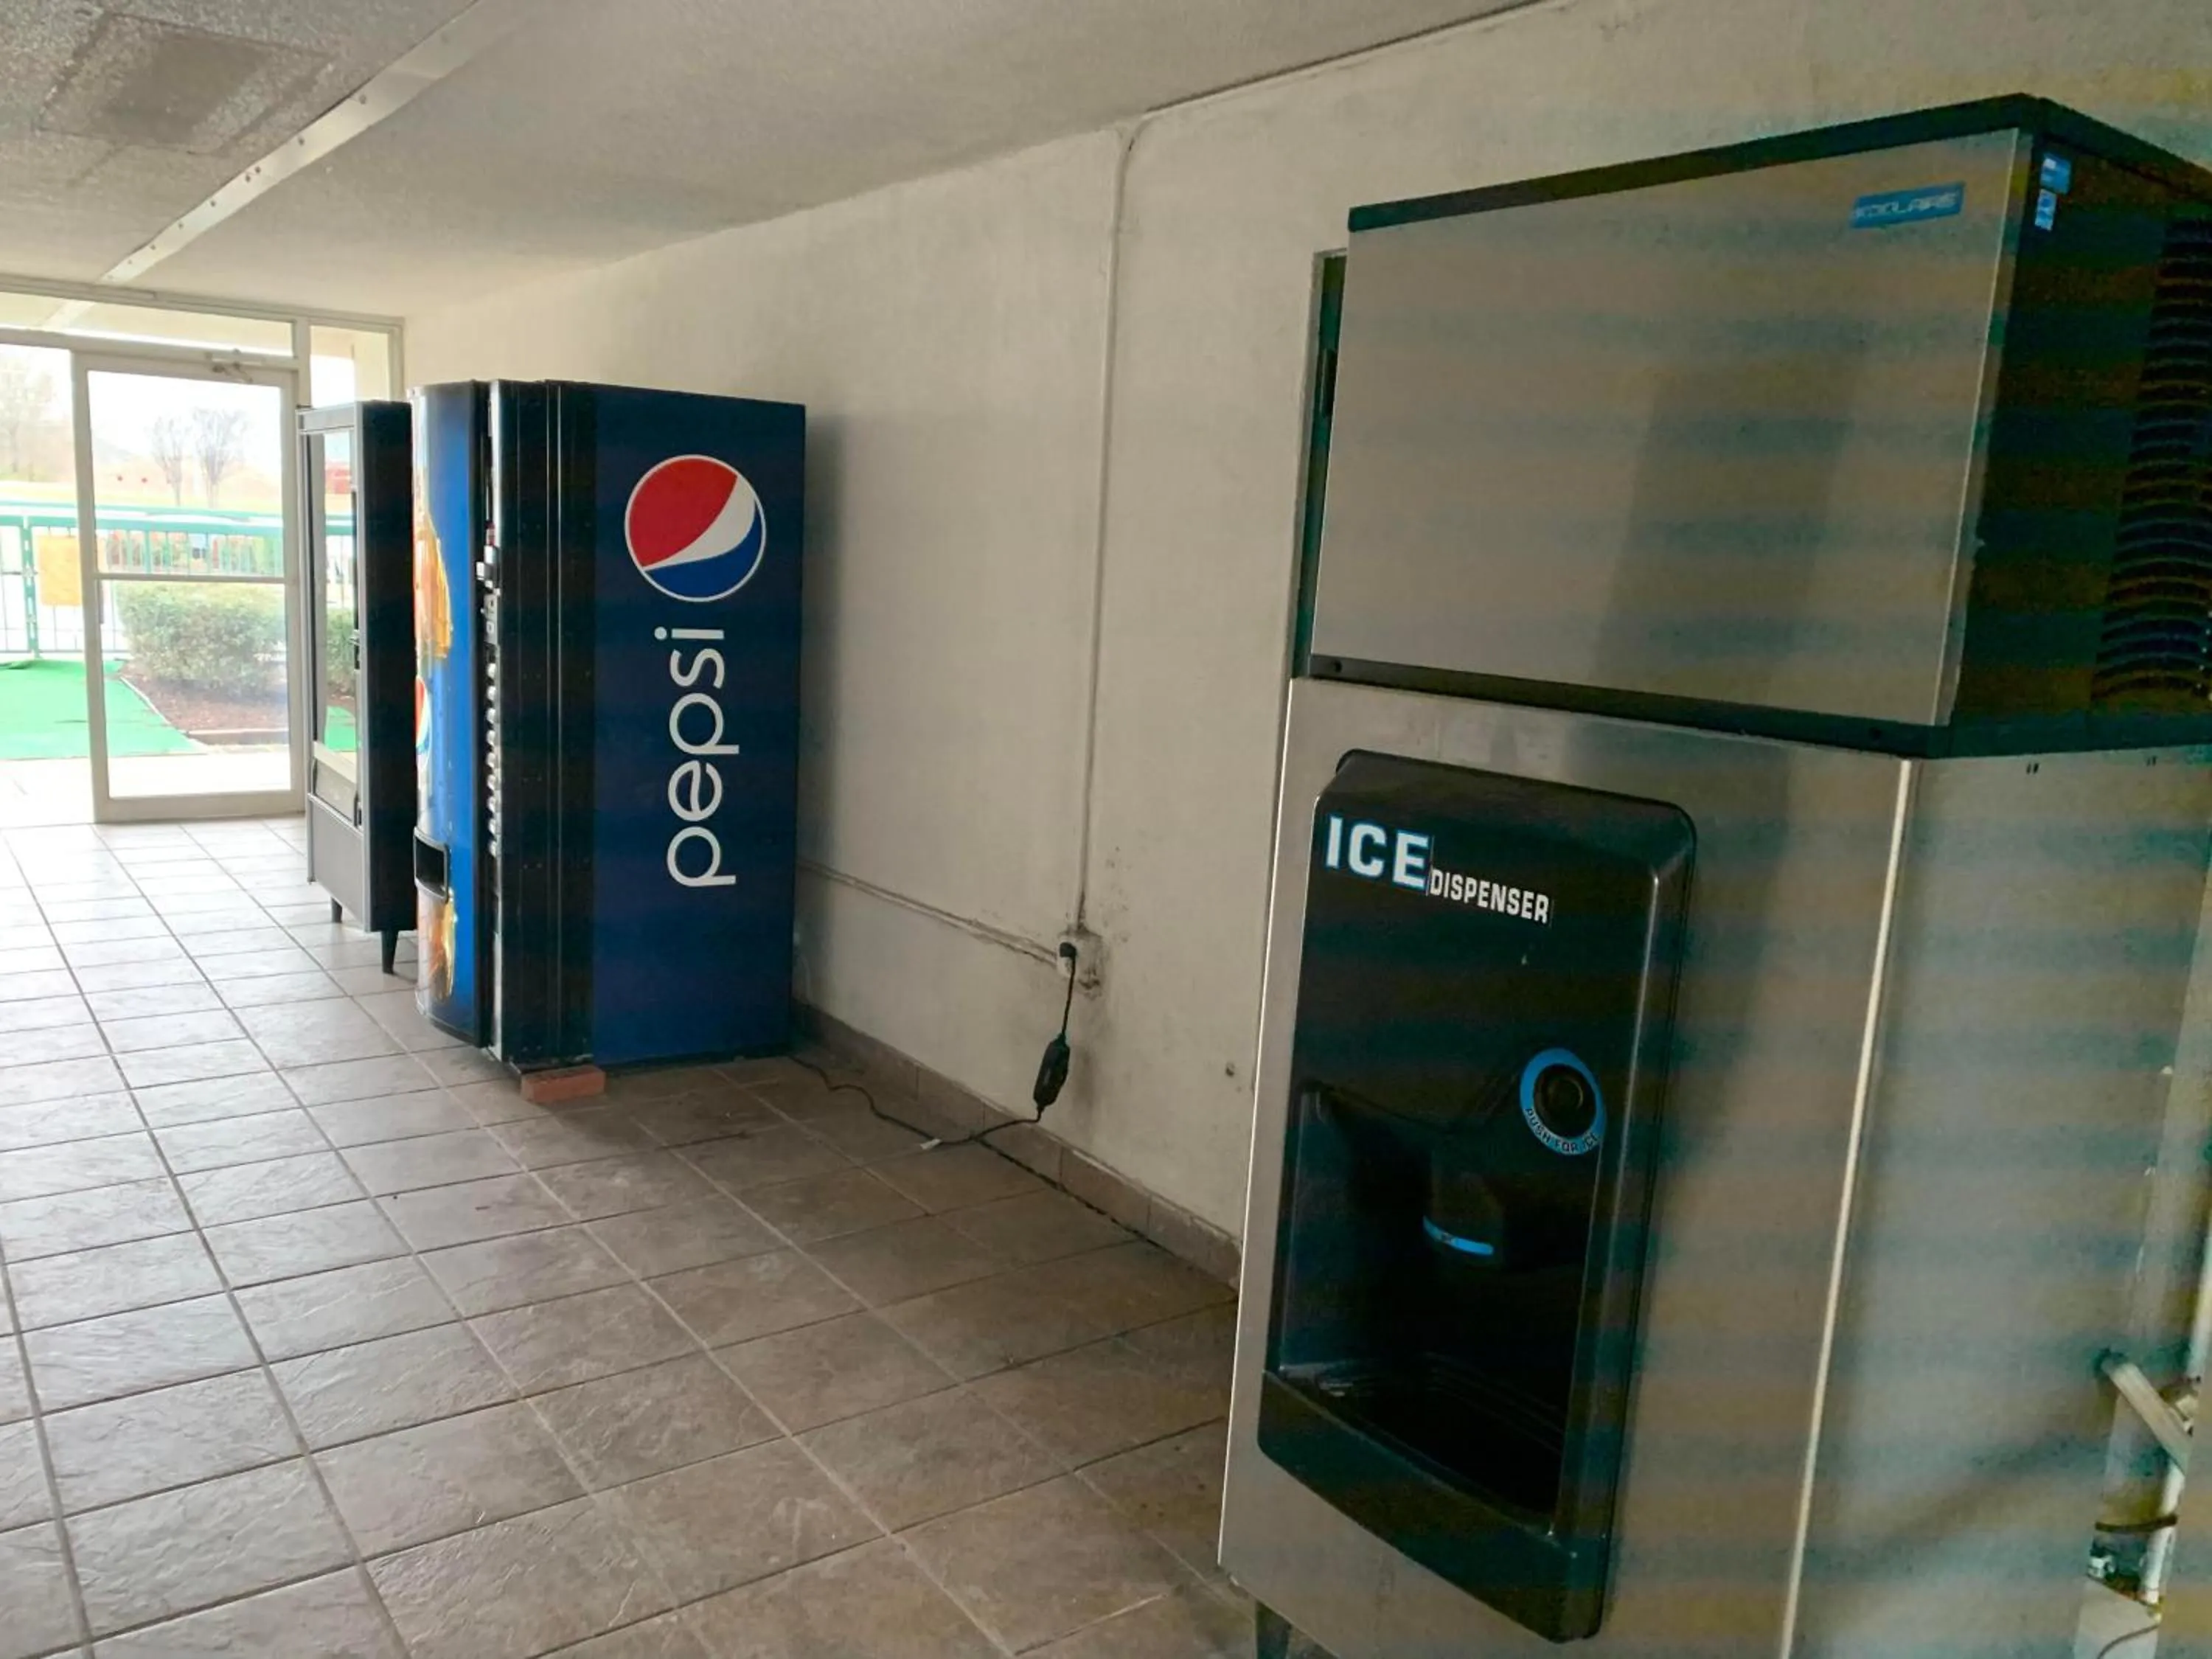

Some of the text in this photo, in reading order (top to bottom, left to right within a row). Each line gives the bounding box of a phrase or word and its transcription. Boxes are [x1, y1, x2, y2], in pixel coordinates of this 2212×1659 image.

[654, 626, 740, 888] pepsi
[1324, 813, 1551, 925] ICE DISPENSER
[1523, 1107, 1552, 1144] PUSH
[1554, 1138, 1579, 1152] FOR
